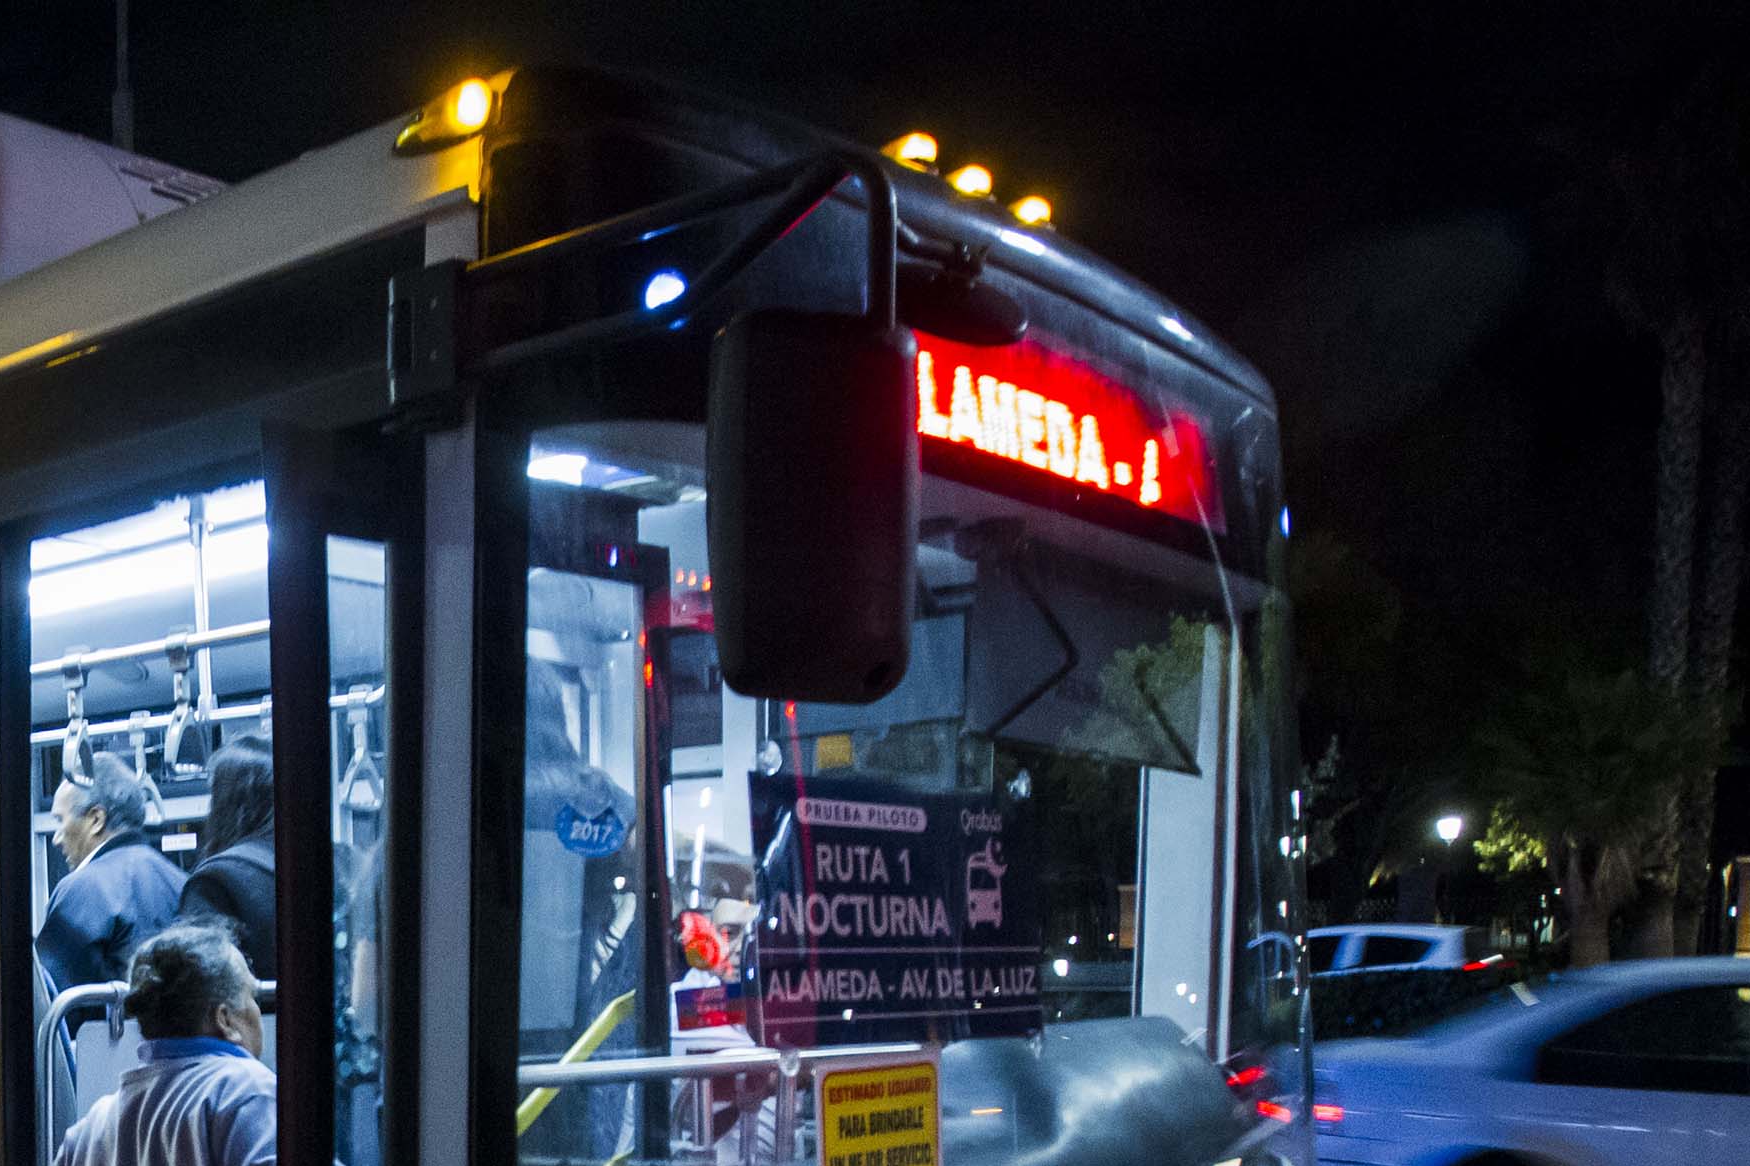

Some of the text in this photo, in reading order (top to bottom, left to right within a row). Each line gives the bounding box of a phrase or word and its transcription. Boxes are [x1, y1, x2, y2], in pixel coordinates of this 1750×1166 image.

[917, 350, 1110, 490] LAMEDA
[570, 820, 613, 843] 2017
[805, 802, 920, 827] PRUEBA PILOTO
[816, 844, 911, 885] RUTA 1
[778, 891, 951, 938] NOCTURNA
[767, 966, 883, 1001] ALAMEDA
[900, 967, 932, 1000] AV.
[937, 969, 965, 999] DE
[970, 966, 994, 998] LA
[1000, 966, 1037, 996] LUZ
[829, 1077, 931, 1106] ESTIMADO USUARIO
[838, 1104, 924, 1139] PARA BRINDARLE
